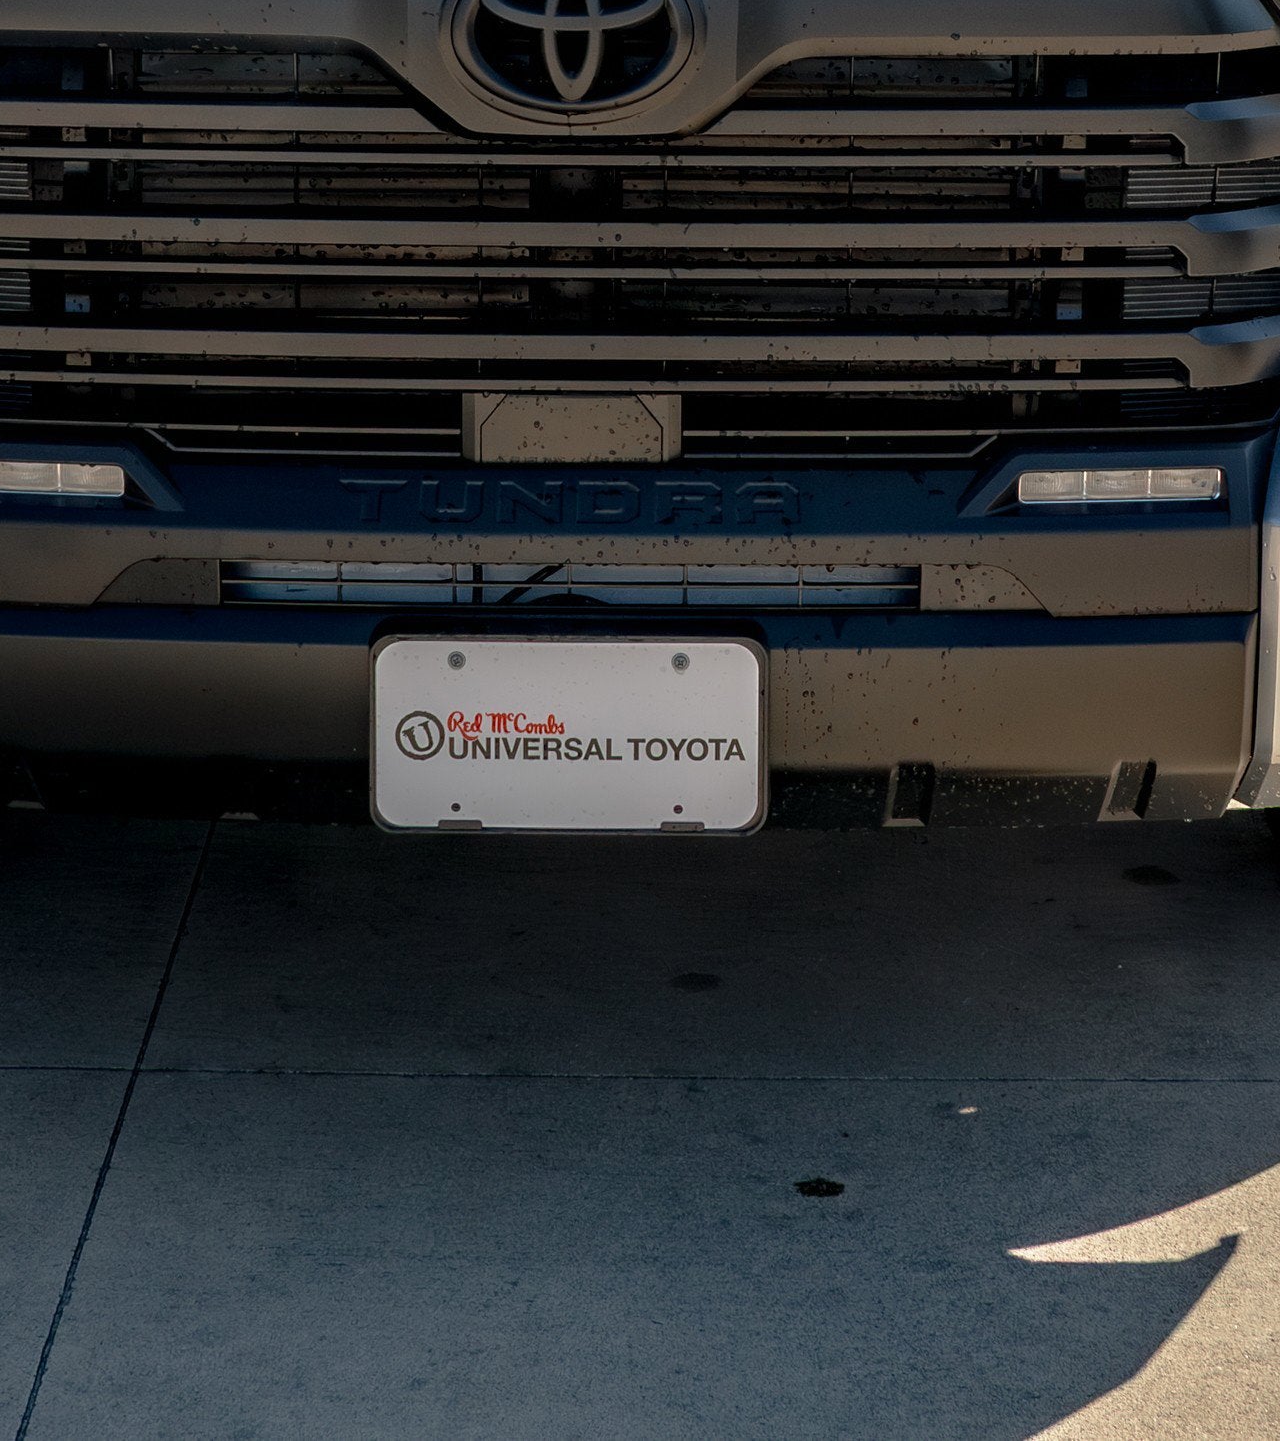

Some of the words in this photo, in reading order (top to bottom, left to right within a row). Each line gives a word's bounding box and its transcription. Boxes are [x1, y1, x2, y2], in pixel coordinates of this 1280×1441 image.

[338, 479, 801, 525] TUNDRA
[447, 710, 483, 742] Red
[449, 736, 624, 761] UNIVERSAL
[626, 737, 746, 761] TOYOTA
